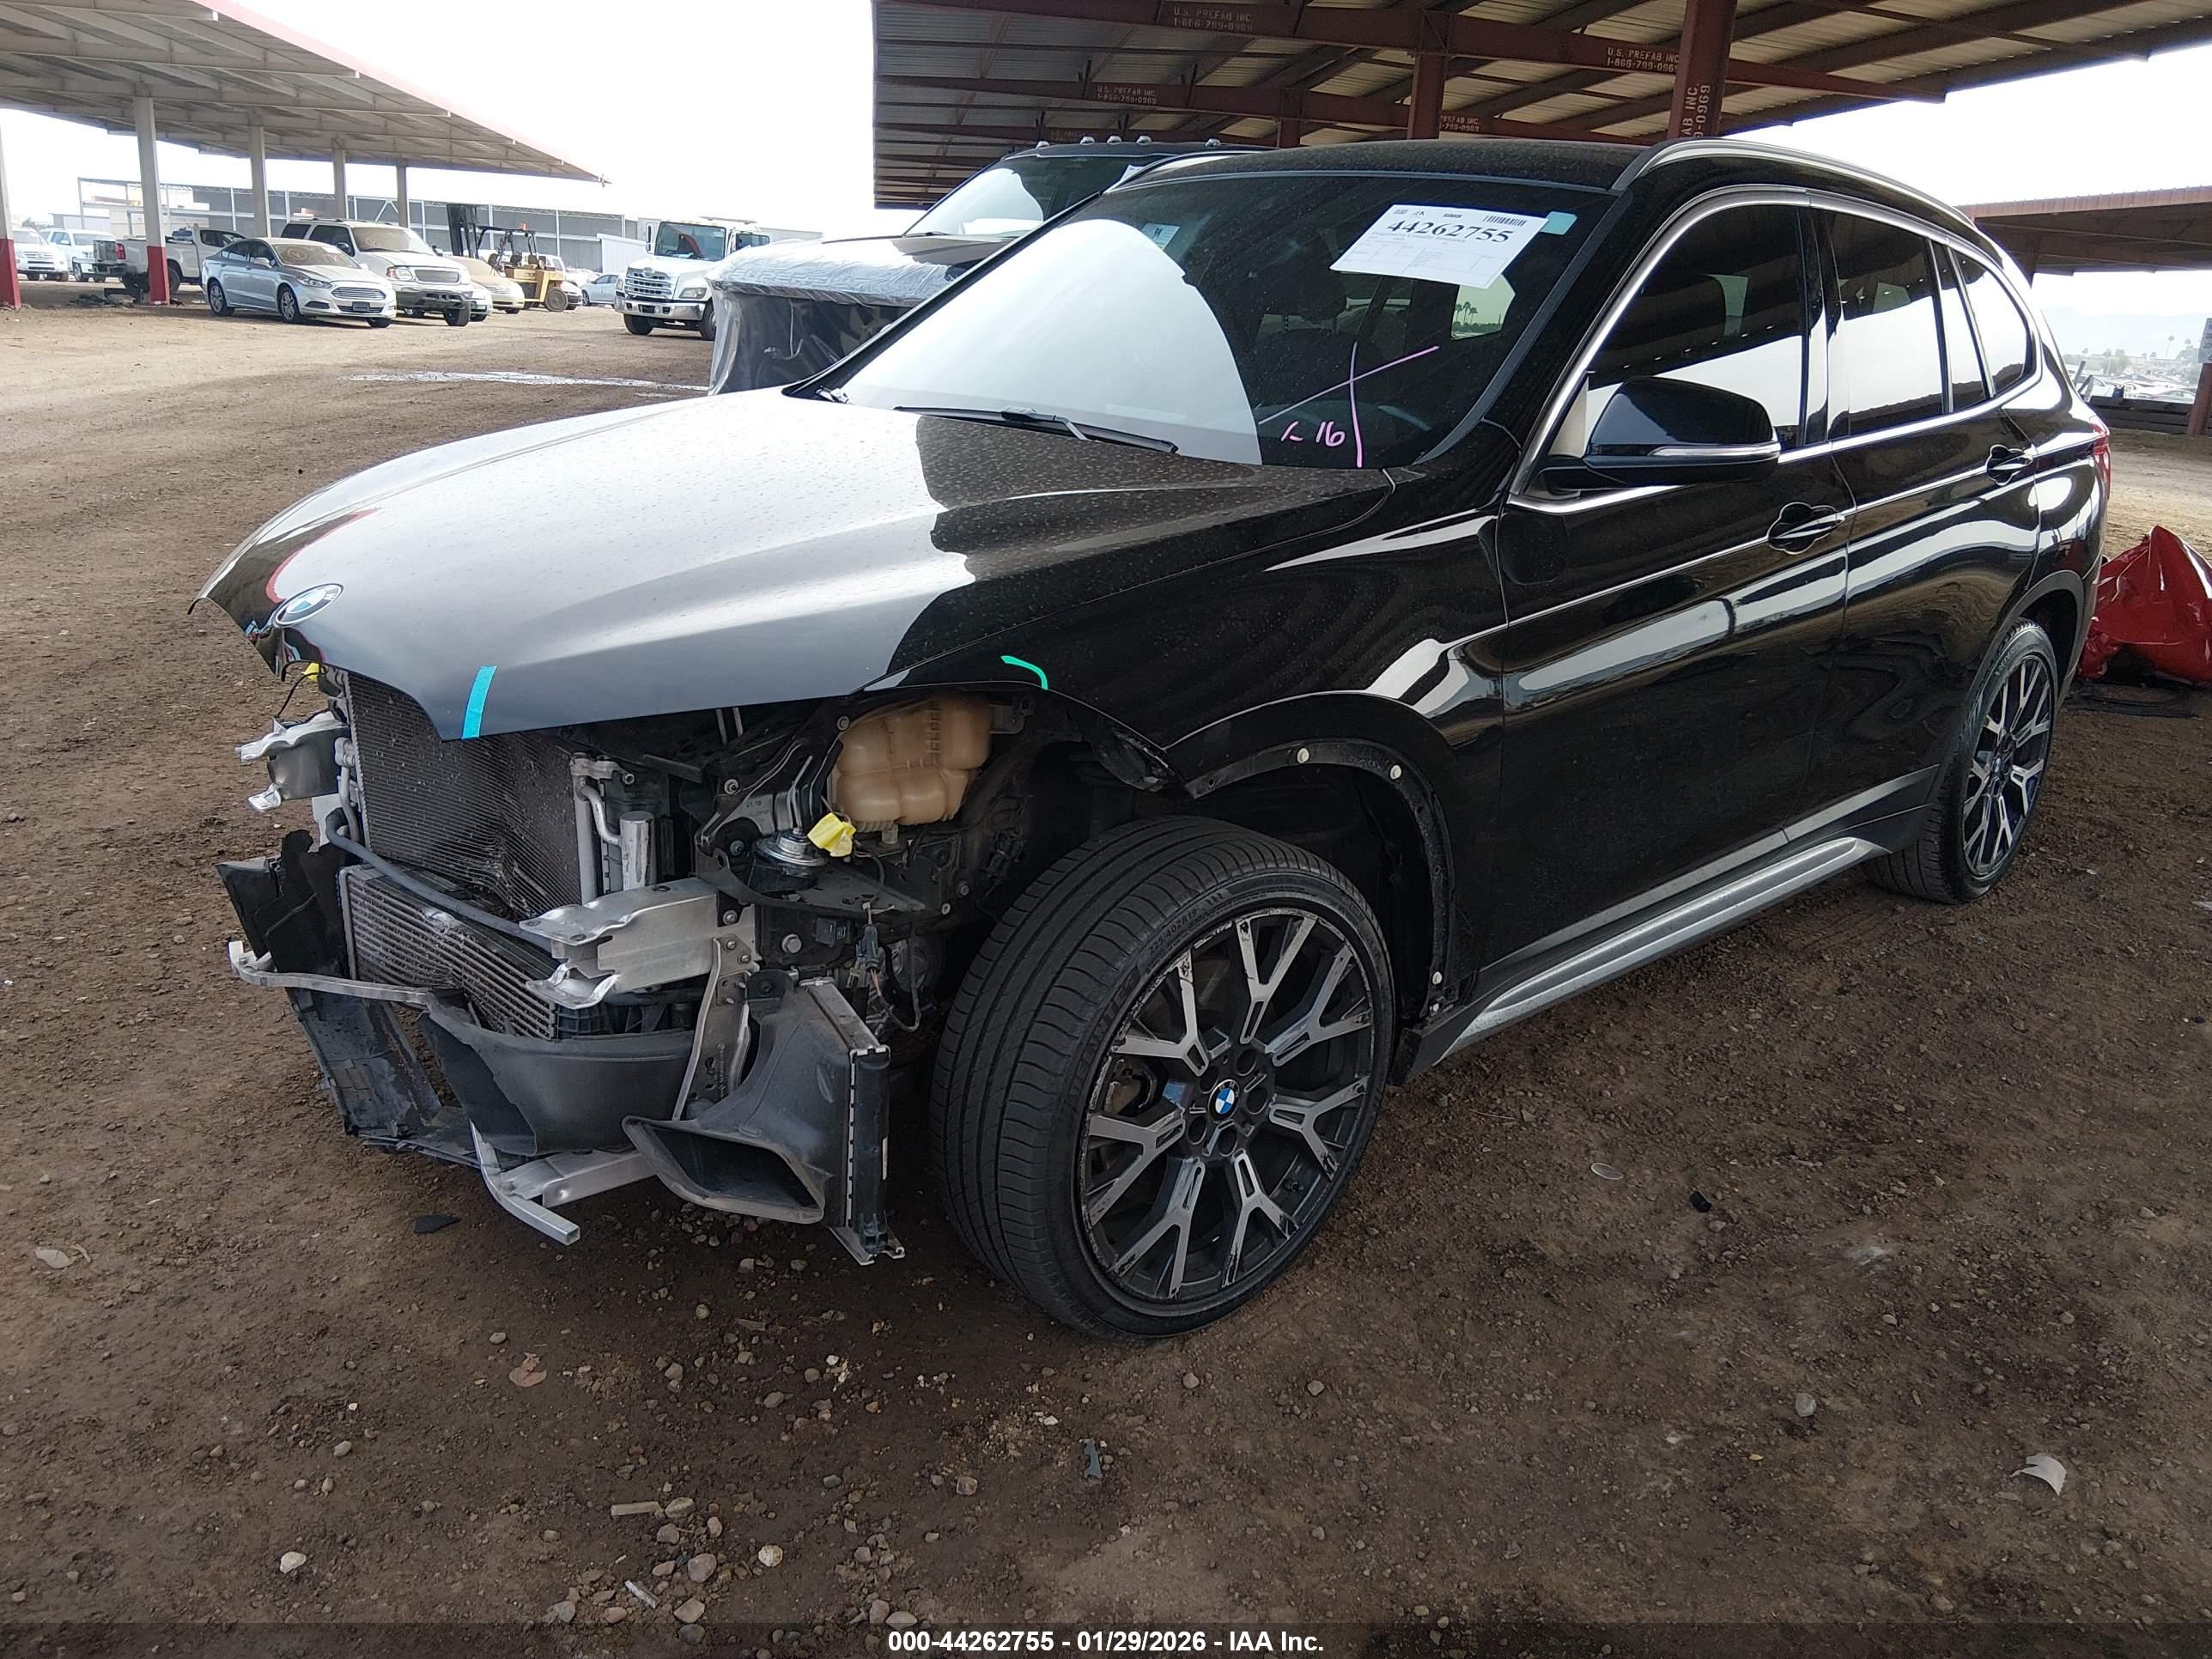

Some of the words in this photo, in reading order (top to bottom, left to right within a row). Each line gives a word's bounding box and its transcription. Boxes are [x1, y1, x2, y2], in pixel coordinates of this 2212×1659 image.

[1607, 46, 1624, 58] U.S.
[1628, 49, 1662, 61] PREFAB
[1387, 220, 1515, 243] 44262755
